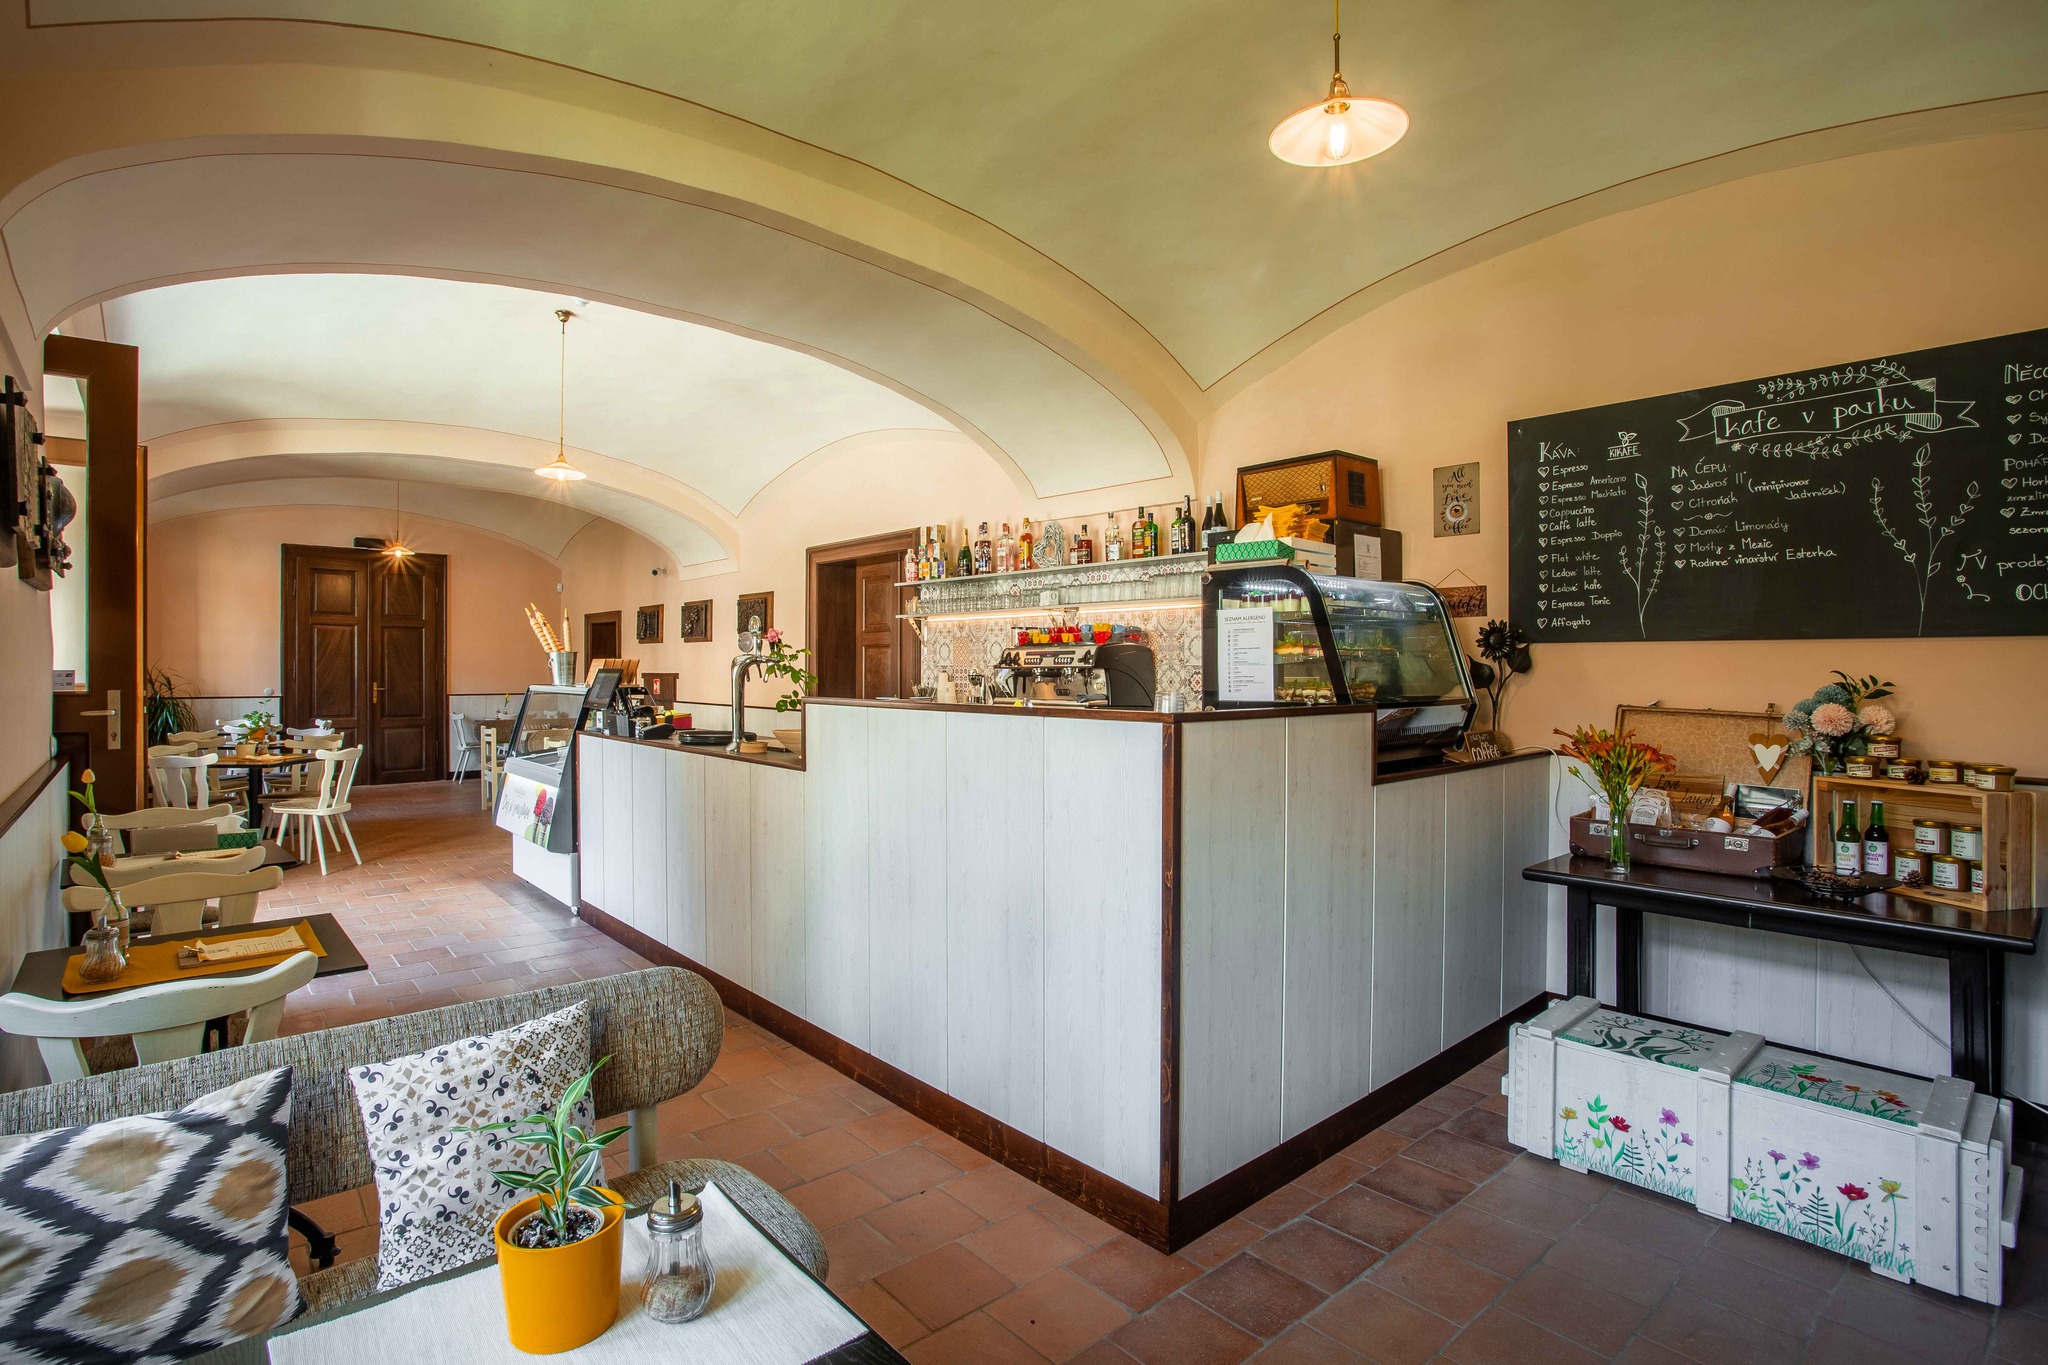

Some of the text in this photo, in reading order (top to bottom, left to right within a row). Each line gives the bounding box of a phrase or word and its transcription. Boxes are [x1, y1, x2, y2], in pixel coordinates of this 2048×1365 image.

[1724, 388, 1916, 437] kafe v parku
[1609, 446, 1639, 458] KIKAFE
[1552, 464, 1589, 477] Espresso
[1552, 475, 1627, 492] Espresso Americano
[1551, 486, 1627, 505] Espresso Machiato
[1549, 506, 1595, 519] Cappuccino
[1576, 515, 1597, 528] latte
[1688, 516, 1789, 537] Domácí Limonády
[1551, 530, 1623, 547] Espresso Doppio
[1551, 551, 1601, 563] Flat white
[1690, 556, 1731, 568] Rodinné
[1785, 545, 1838, 560] Esterka
[1583, 566, 1603, 576] latte
[1584, 579, 1602, 590] kafe
[1551, 595, 1611, 610] Espresso Tonic
[1551, 615, 1591, 629] Affogato
[1654, 774, 1680, 789] Love
